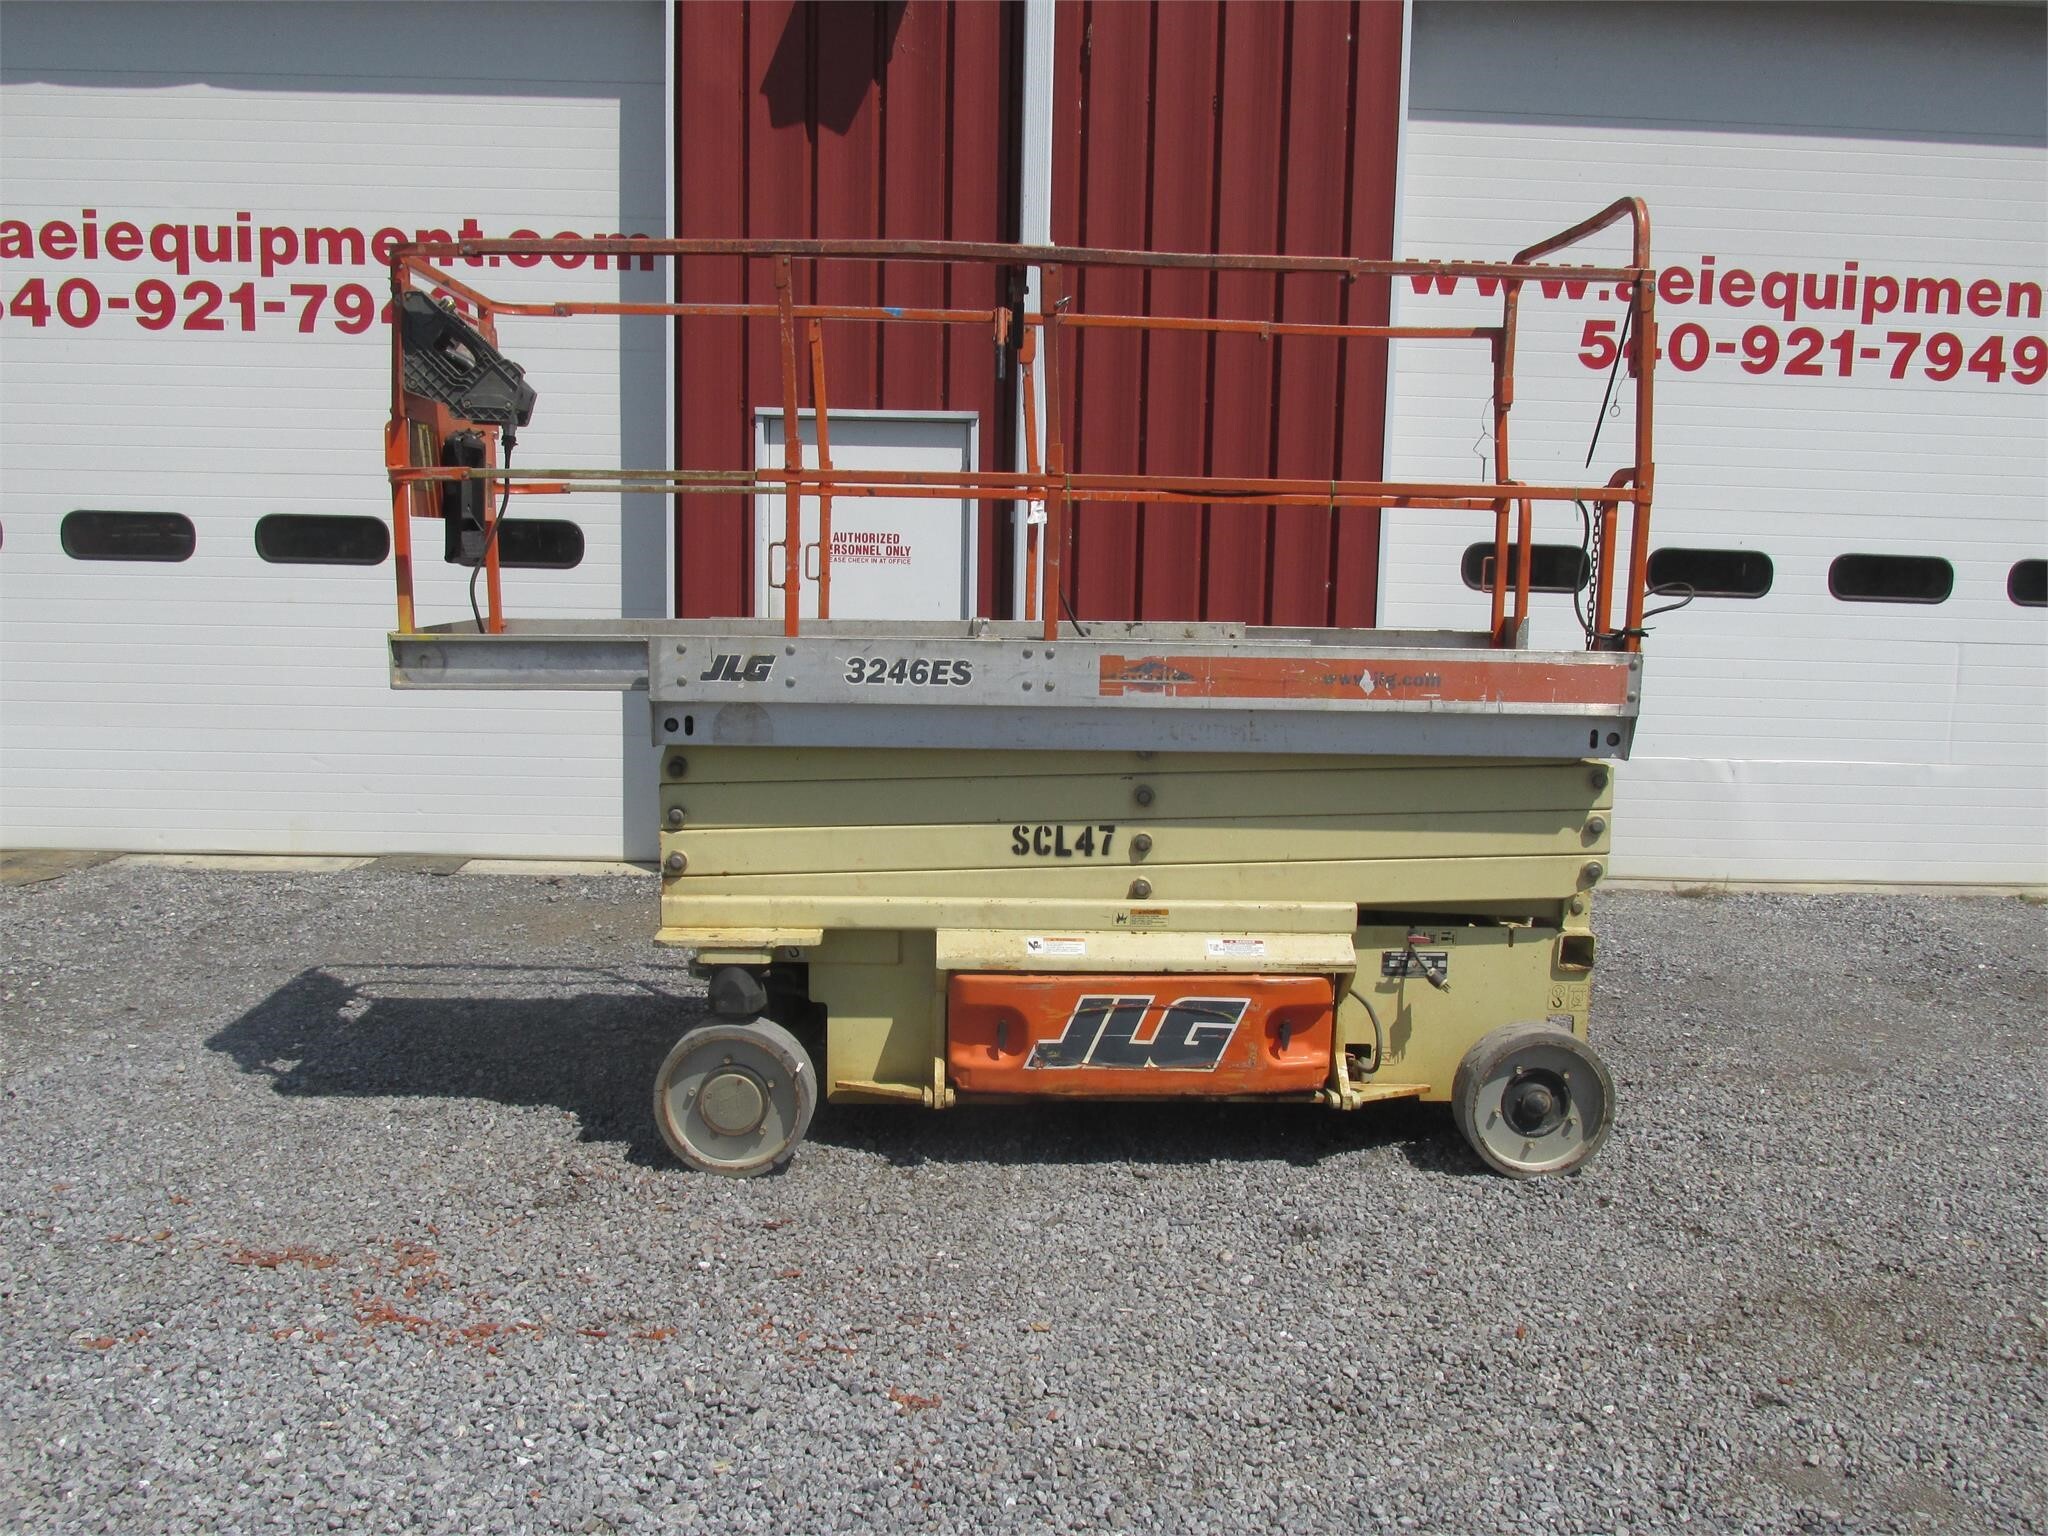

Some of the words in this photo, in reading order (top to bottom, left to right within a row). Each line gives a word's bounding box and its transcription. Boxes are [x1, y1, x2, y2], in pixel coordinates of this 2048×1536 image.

[0, 276, 478, 334] 40-921-79
[830, 544, 881, 556] ERSONNEL
[886, 546, 911, 557] ONLY
[833, 532, 900, 544] AUTHORIZED
[700, 655, 777, 682] JLG
[844, 656, 973, 686] 3246ES
[1012, 825, 1115, 857] SCL47
[1023, 995, 1251, 1072] JLG
